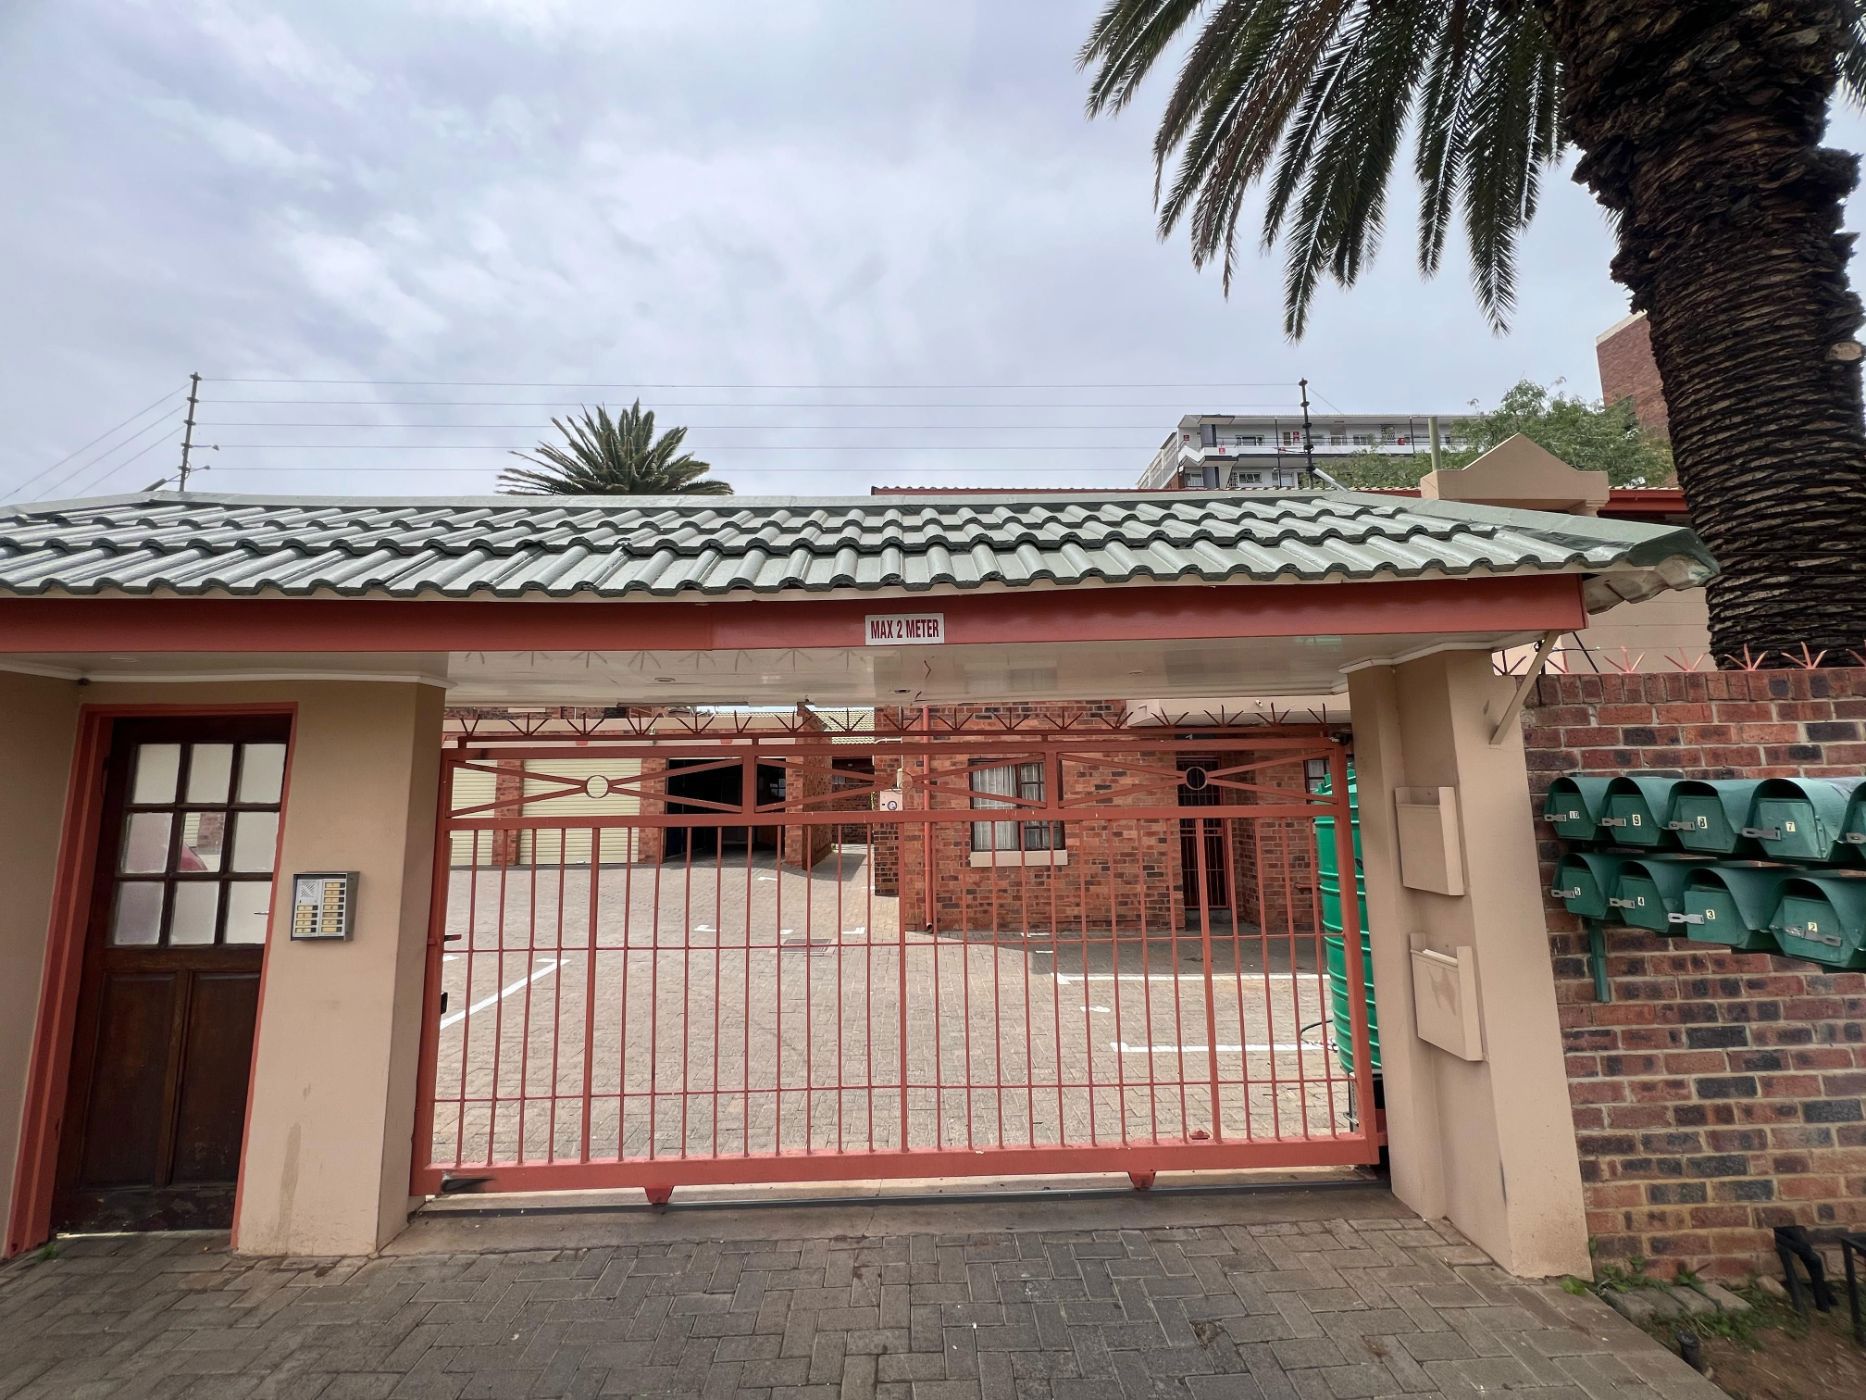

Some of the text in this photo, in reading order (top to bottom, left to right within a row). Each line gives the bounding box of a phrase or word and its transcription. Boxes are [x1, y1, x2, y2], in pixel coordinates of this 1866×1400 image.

[870, 619, 939, 639] MAX 2 METER
[1633, 815, 1640, 824] 9
[1699, 817, 1706, 827] 8
[1708, 910, 1714, 918] 3
